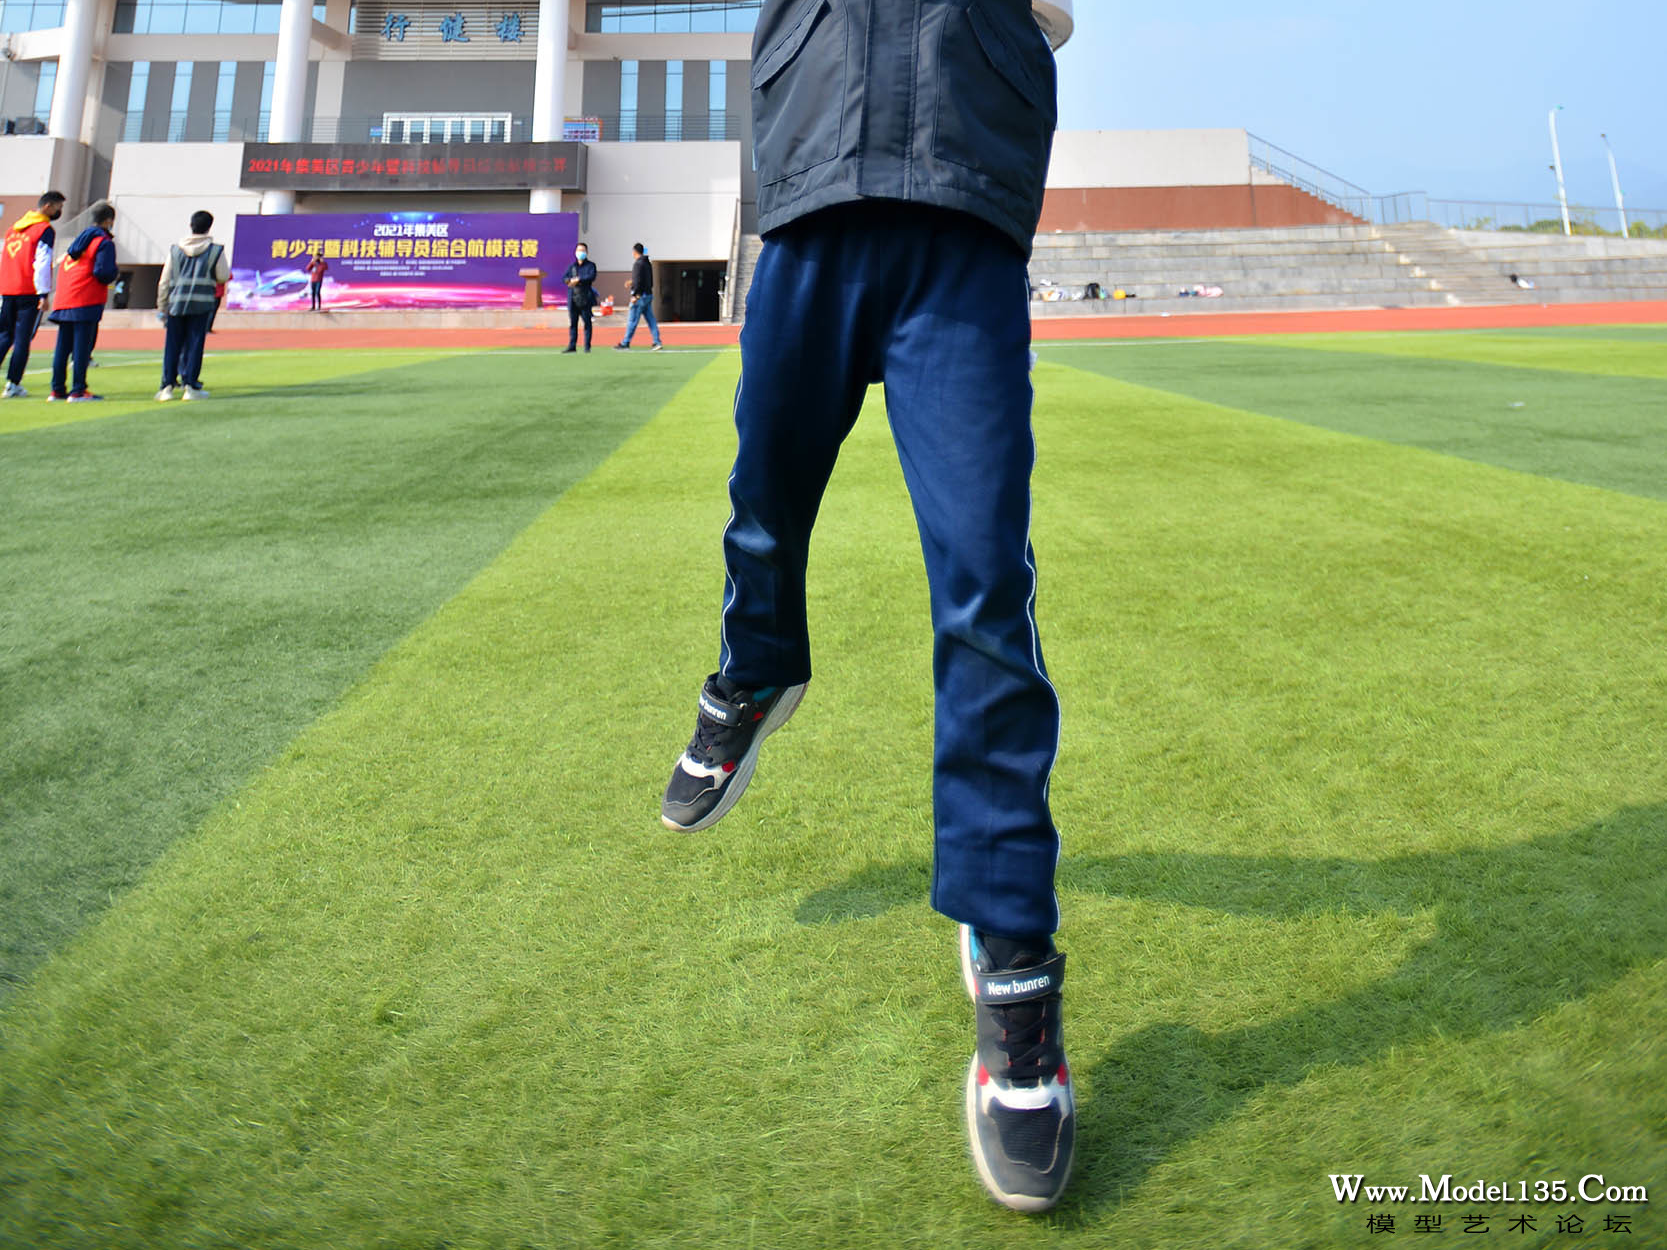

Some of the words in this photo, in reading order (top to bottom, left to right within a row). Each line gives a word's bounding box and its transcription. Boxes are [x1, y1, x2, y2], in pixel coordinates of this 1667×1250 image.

[381, 12, 525, 43] 行健楼
[373, 223, 449, 237] 2021年集美区
[271, 238, 539, 259] 青少年暨科技辅导员综合航模竞赛
[987, 981, 1011, 996] New
[1012, 975, 1050, 994] bunren
